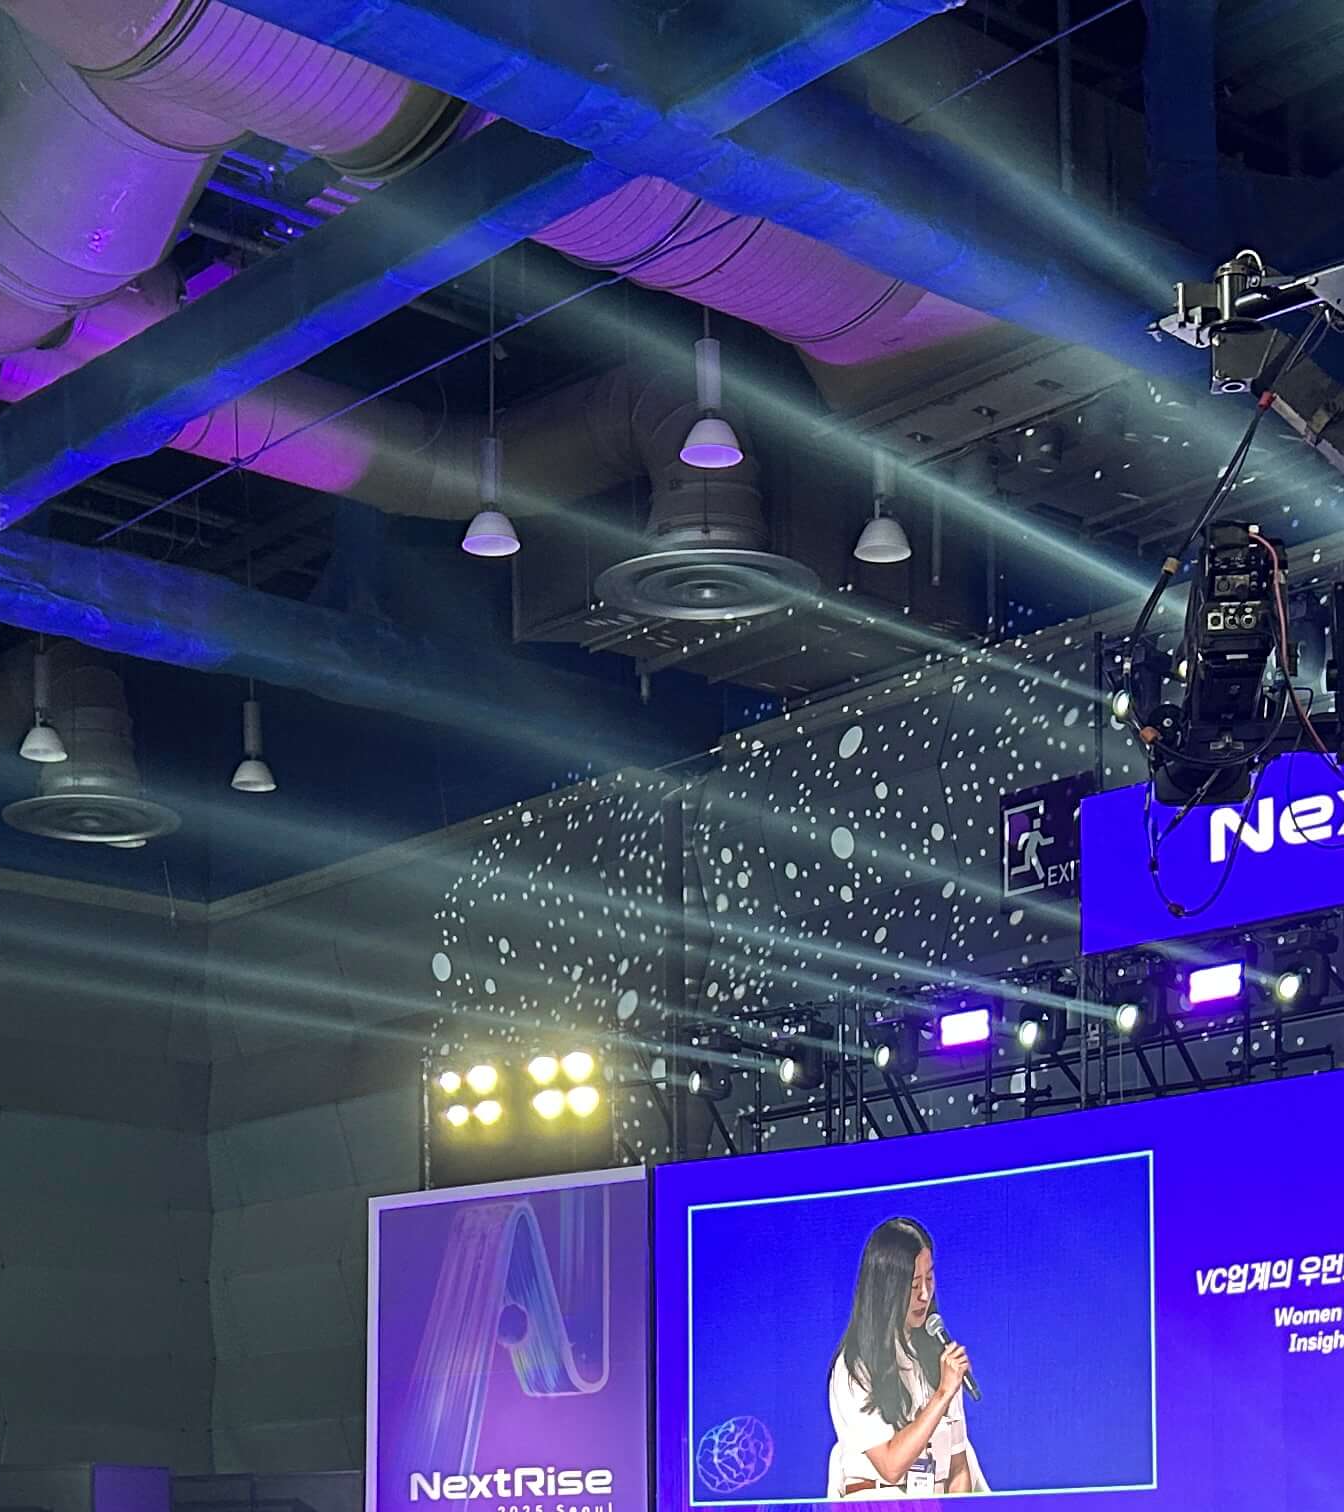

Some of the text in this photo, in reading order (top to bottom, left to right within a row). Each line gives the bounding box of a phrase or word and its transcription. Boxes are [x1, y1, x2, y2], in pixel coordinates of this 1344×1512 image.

[1047, 859, 1080, 887] EXI
[1195, 1258, 1293, 1296] VC업계의
[1274, 1306, 1343, 1327] Women
[409, 1466, 614, 1502] NextRise
